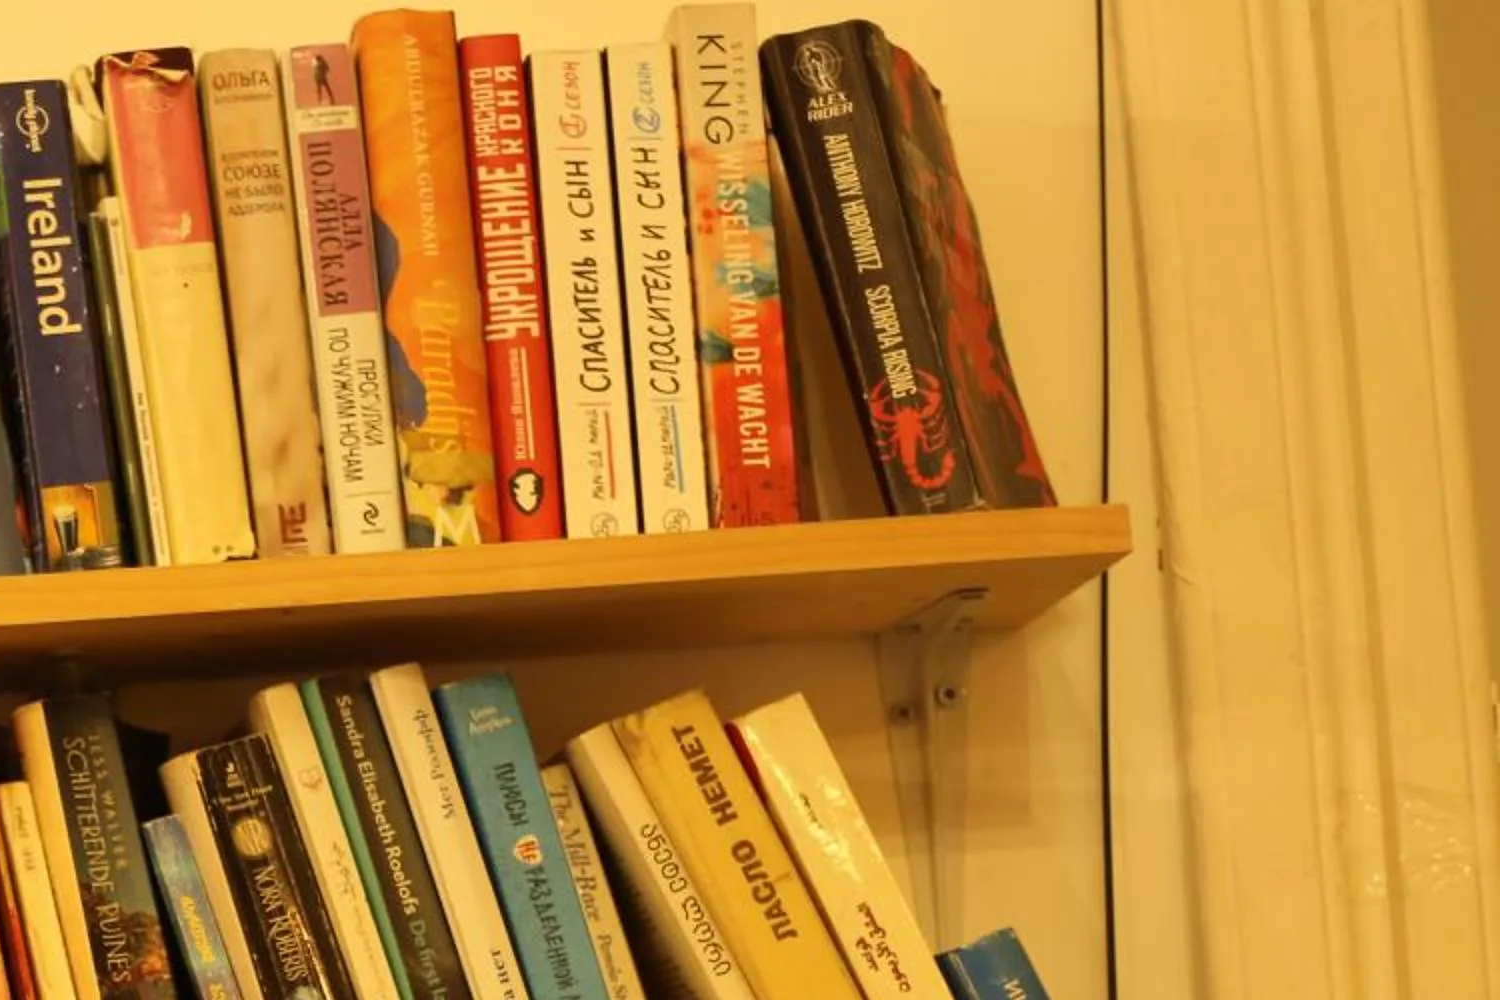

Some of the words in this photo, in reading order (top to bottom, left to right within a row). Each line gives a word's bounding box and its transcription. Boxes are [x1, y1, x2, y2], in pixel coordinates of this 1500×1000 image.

[213, 71, 271, 91] ОЛЬГА
[401, 31, 431, 166] ABDULRAZAK
[467, 66, 500, 157] КРАСНОГО
[494, 64, 524, 154] КОНЯ
[561, 60, 583, 110] СЕЗОН
[696, 32, 733, 145] KING
[730, 41, 750, 134] STEPHEN
[807, 102, 853, 122] RIDER
[808, 91, 847, 107] ALEX
[222, 163, 282, 181] СОЮЗЕ
[563, 158, 593, 219] СЫН
[631, 144, 662, 209] СЫН
[821, 129, 863, 200] ANTHONY
[306, 140, 347, 306] ПОЛЯНСКАЯ
[338, 191, 364, 250] АЛЛА
[415, 171, 440, 256] GURNAH
[714, 150, 756, 284] WISSELING
[839, 197, 884, 275] HOROWITZ
[21, 175, 82, 337] Ireland
[471, 161, 543, 342] УКРОЩЕНИЕ
[328, 327, 349, 352] ПО
[727, 289, 759, 342] VAN
[862, 282, 905, 351] SCORPIA
[330, 354, 356, 419] ЧУЖИМ
[403, 278, 481, 459] Paradijs
[732, 346, 762, 377] DE
[880, 347, 918, 400] RISING
[356, 357, 384, 447] ПРОГУЛКИ
[736, 382, 770, 469] WACHT
[337, 421, 363, 482] НОЧАМ
[334, 693, 371, 760] Sandra
[356, 758, 399, 845] Elisabeth
[432, 780, 459, 820] Мег
[492, 760, 531, 828] ПЛЮСЫ
[547, 783, 578, 825] The
[667, 716, 741, 828] НЕМЕТ
[61, 733, 118, 895] SCHITTERENDE
[251, 863, 287, 913] NORA
[384, 843, 422, 916] Roelofs
[561, 827, 609, 924] Mill-Race
[726, 834, 802, 947] ЛАСЛО
[263, 913, 310, 983] ROBERTS
[408, 918, 431, 947] De
[487, 945, 511, 988] нет
[417, 946, 445, 989] first
